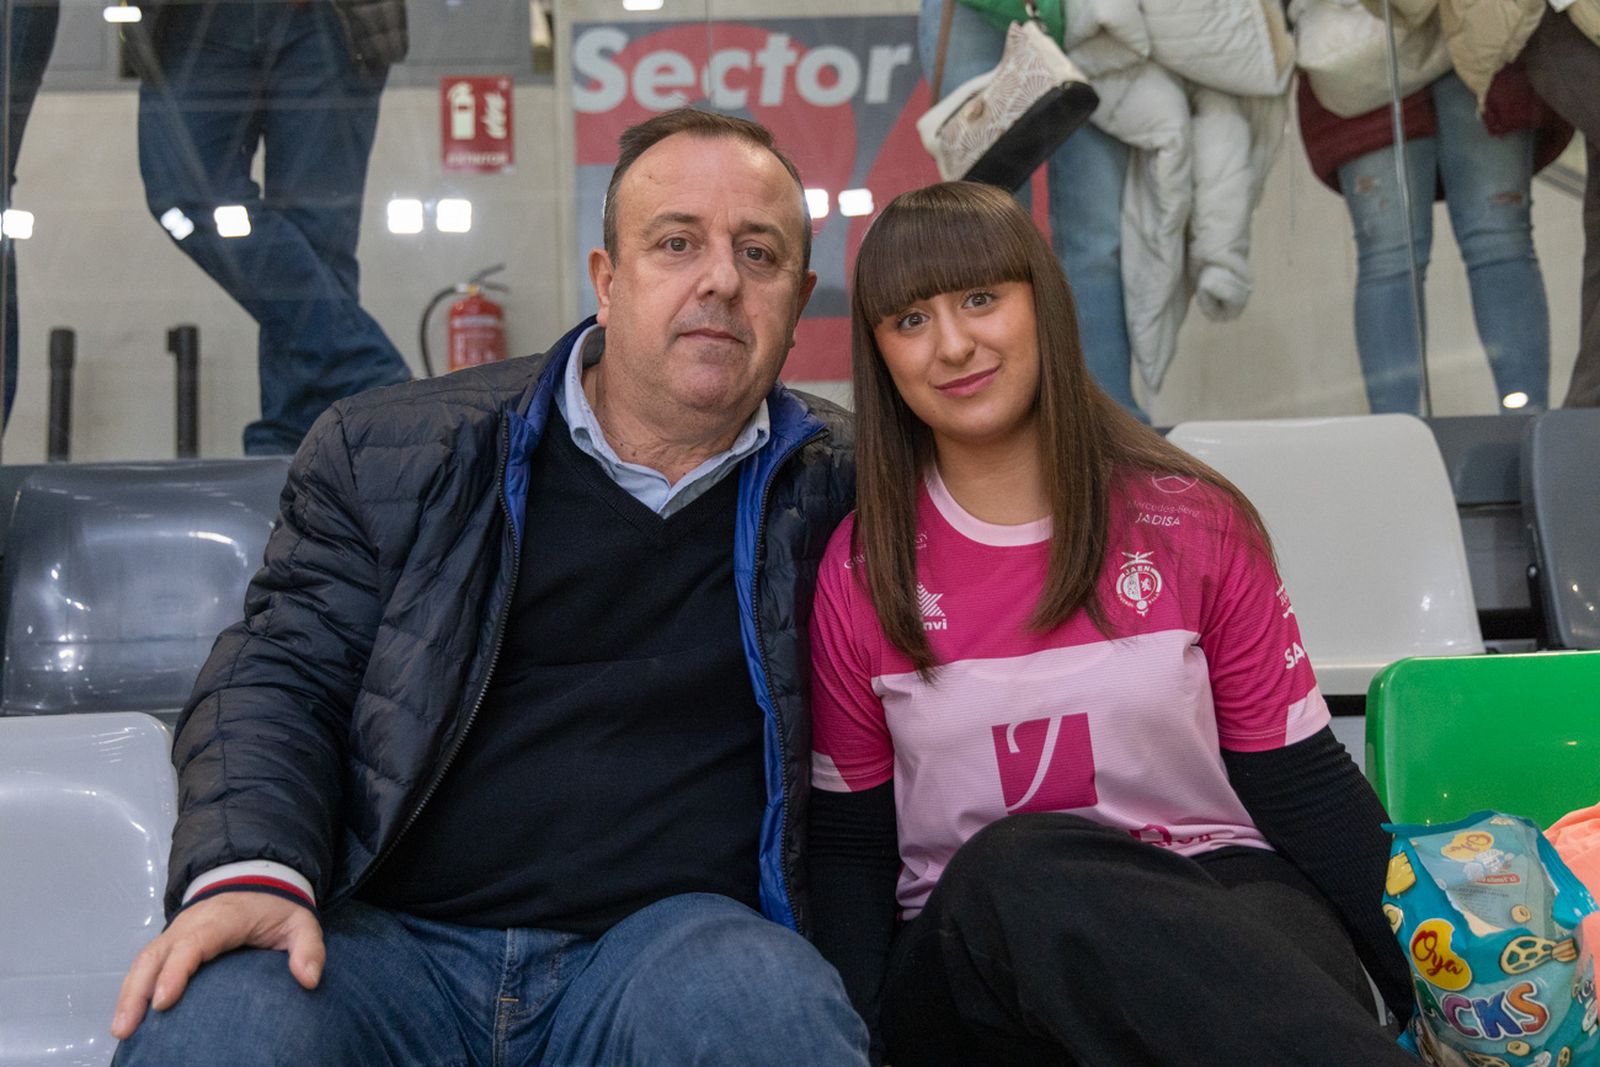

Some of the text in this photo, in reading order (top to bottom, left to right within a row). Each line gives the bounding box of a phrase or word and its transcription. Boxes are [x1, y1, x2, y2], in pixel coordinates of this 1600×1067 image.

[574, 26, 912, 113] Sector
[1135, 512, 1180, 526] JADISA
[922, 618, 948, 631] nvi
[1412, 930, 1463, 976] Oya
